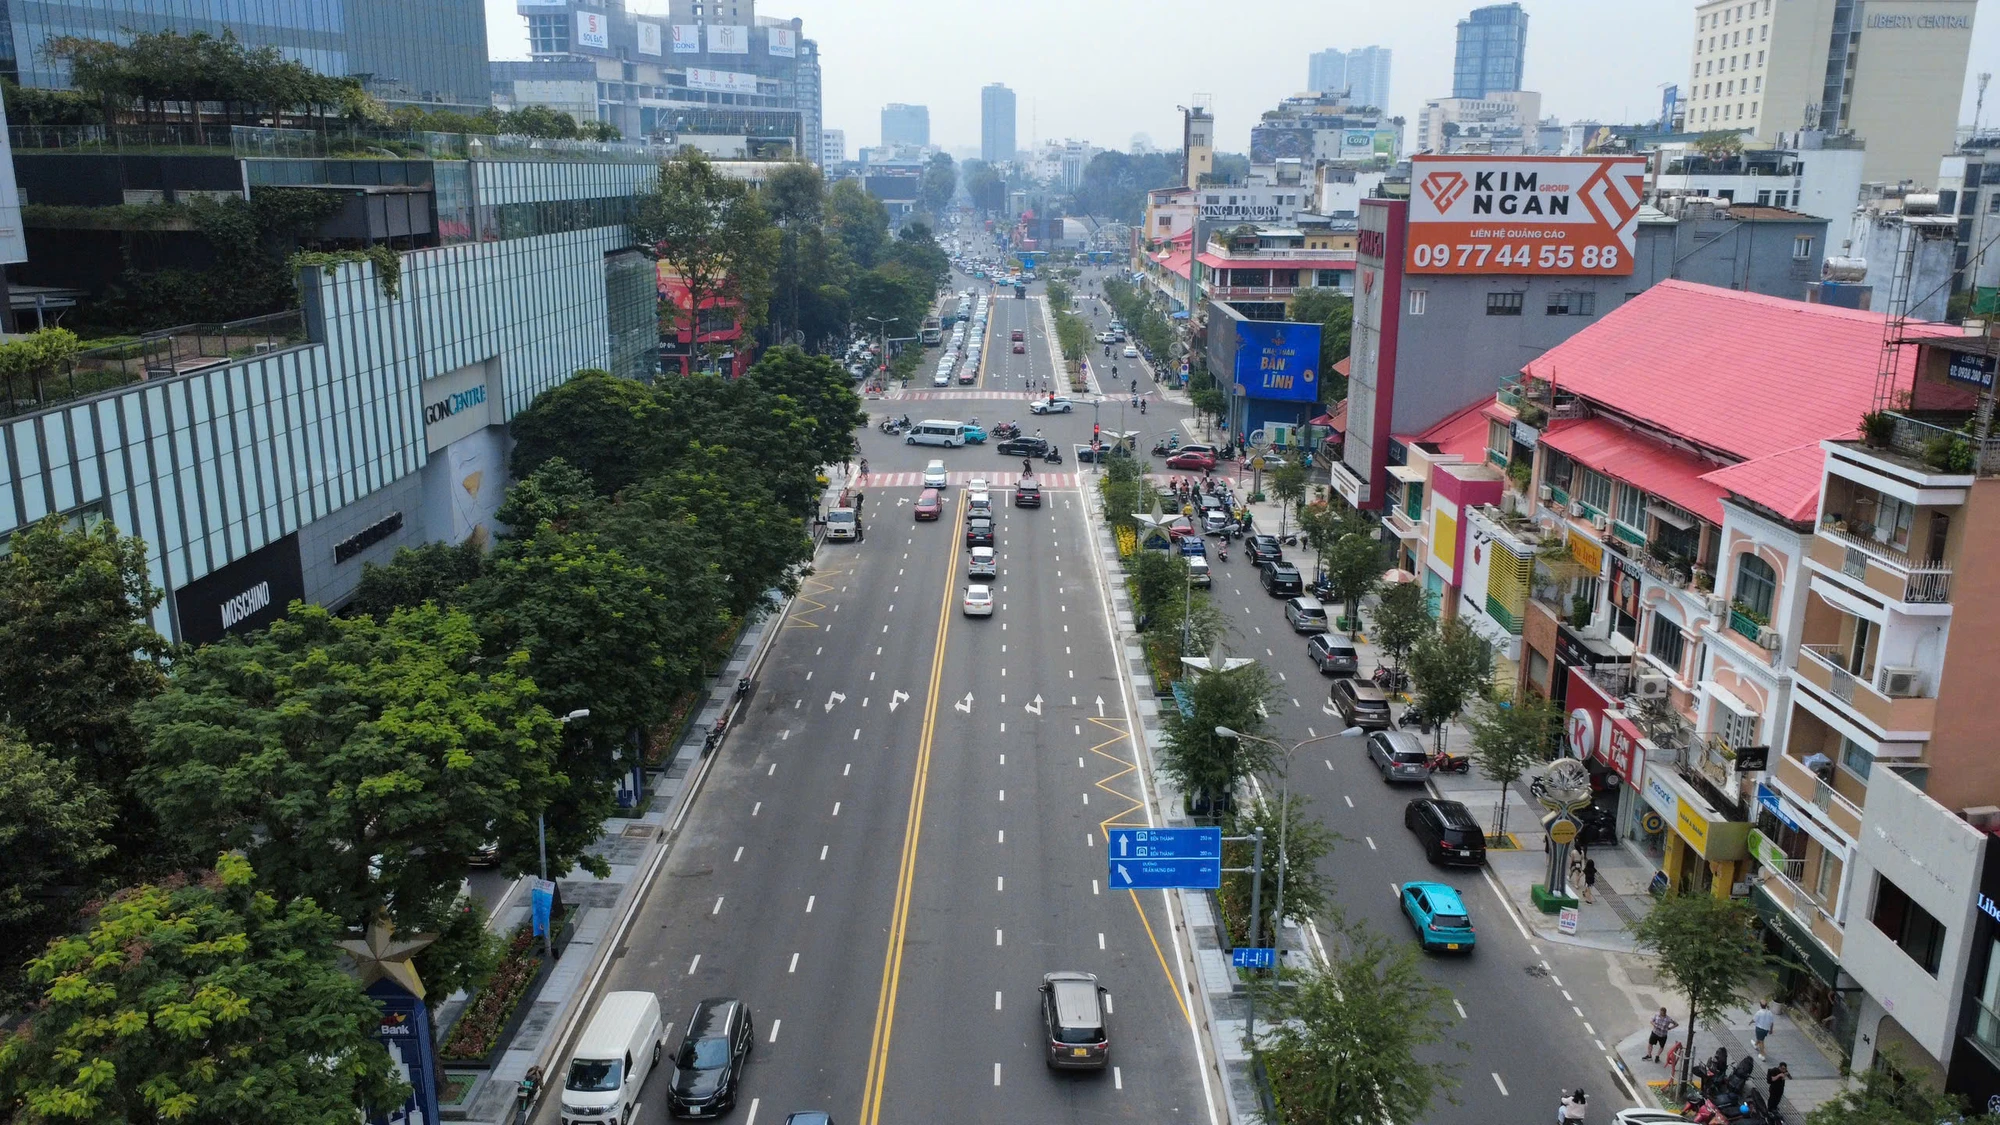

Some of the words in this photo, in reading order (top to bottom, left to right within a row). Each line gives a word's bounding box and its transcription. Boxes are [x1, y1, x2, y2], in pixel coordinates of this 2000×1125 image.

[1867, 15, 1912, 28] LIBERTY
[1917, 15, 1969, 29] CENTRAL
[1475, 171, 1537, 192] KIM
[1539, 184, 1569, 192] GROUP
[1200, 205, 1232, 216] KING
[1233, 205, 1278, 216] LUXURY
[1473, 195, 1569, 215] NGAN
[1470, 229, 1489, 238] LIÊN
[1413, 244, 1450, 267] 09
[1538, 245, 1575, 268] 55
[1581, 245, 1618, 268] 88
[220, 581, 271, 630] MOSCHINO
[1574, 719, 1587, 760] K
[381, 1024, 410, 1035] Bank
